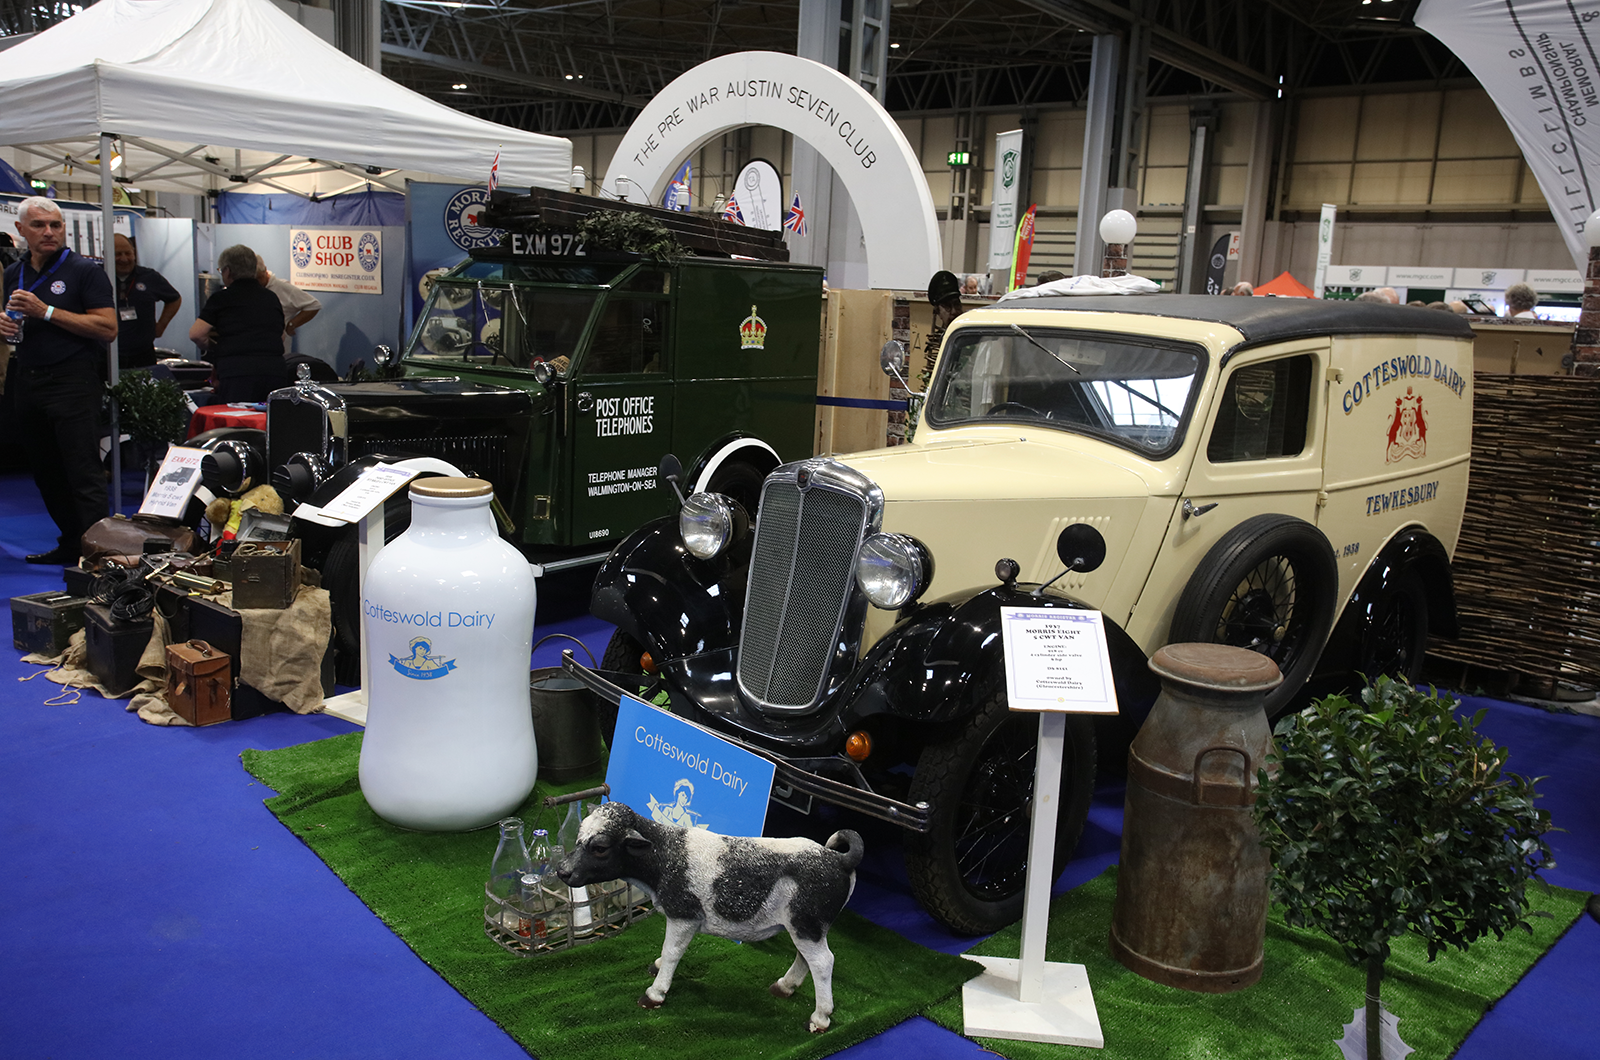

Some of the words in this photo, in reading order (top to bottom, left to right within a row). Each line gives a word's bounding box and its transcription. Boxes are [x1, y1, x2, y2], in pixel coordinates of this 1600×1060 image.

[634, 136, 660, 167] THE
[658, 107, 684, 138] PRE
[686, 87, 720, 114] WAR
[726, 80, 783, 99] AUSTIN
[787, 86, 840, 128] SEVEN
[838, 121, 878, 169] CLUB
[450, 192, 492, 215] MORR
[316, 236, 353, 250] CLUB
[448, 219, 504, 248] REGISTE
[512, 234, 546, 255] EXM
[550, 234, 586, 256] 972
[315, 252, 354, 266] SHOP
[1342, 354, 1432, 416] COTTESWOLD
[1434, 359, 1466, 400] DAIRY
[596, 398, 620, 417] POST
[622, 396, 654, 416] OFFICE
[596, 416, 653, 437] TELEPHONES
[588, 470, 626, 483] TELEPHONE
[627, 466, 658, 479] MANAGER
[588, 480, 656, 497] WALMINGTON-ON-SEA
[1366, 480, 1439, 516] TEWKESBURY
[1342, 542, 1360, 558] 1938
[364, 599, 442, 627] Cotteswold
[448, 611, 495, 629] Dairy
[635, 726, 710, 775] Cotteswold
[712, 762, 748, 797] Dairy
